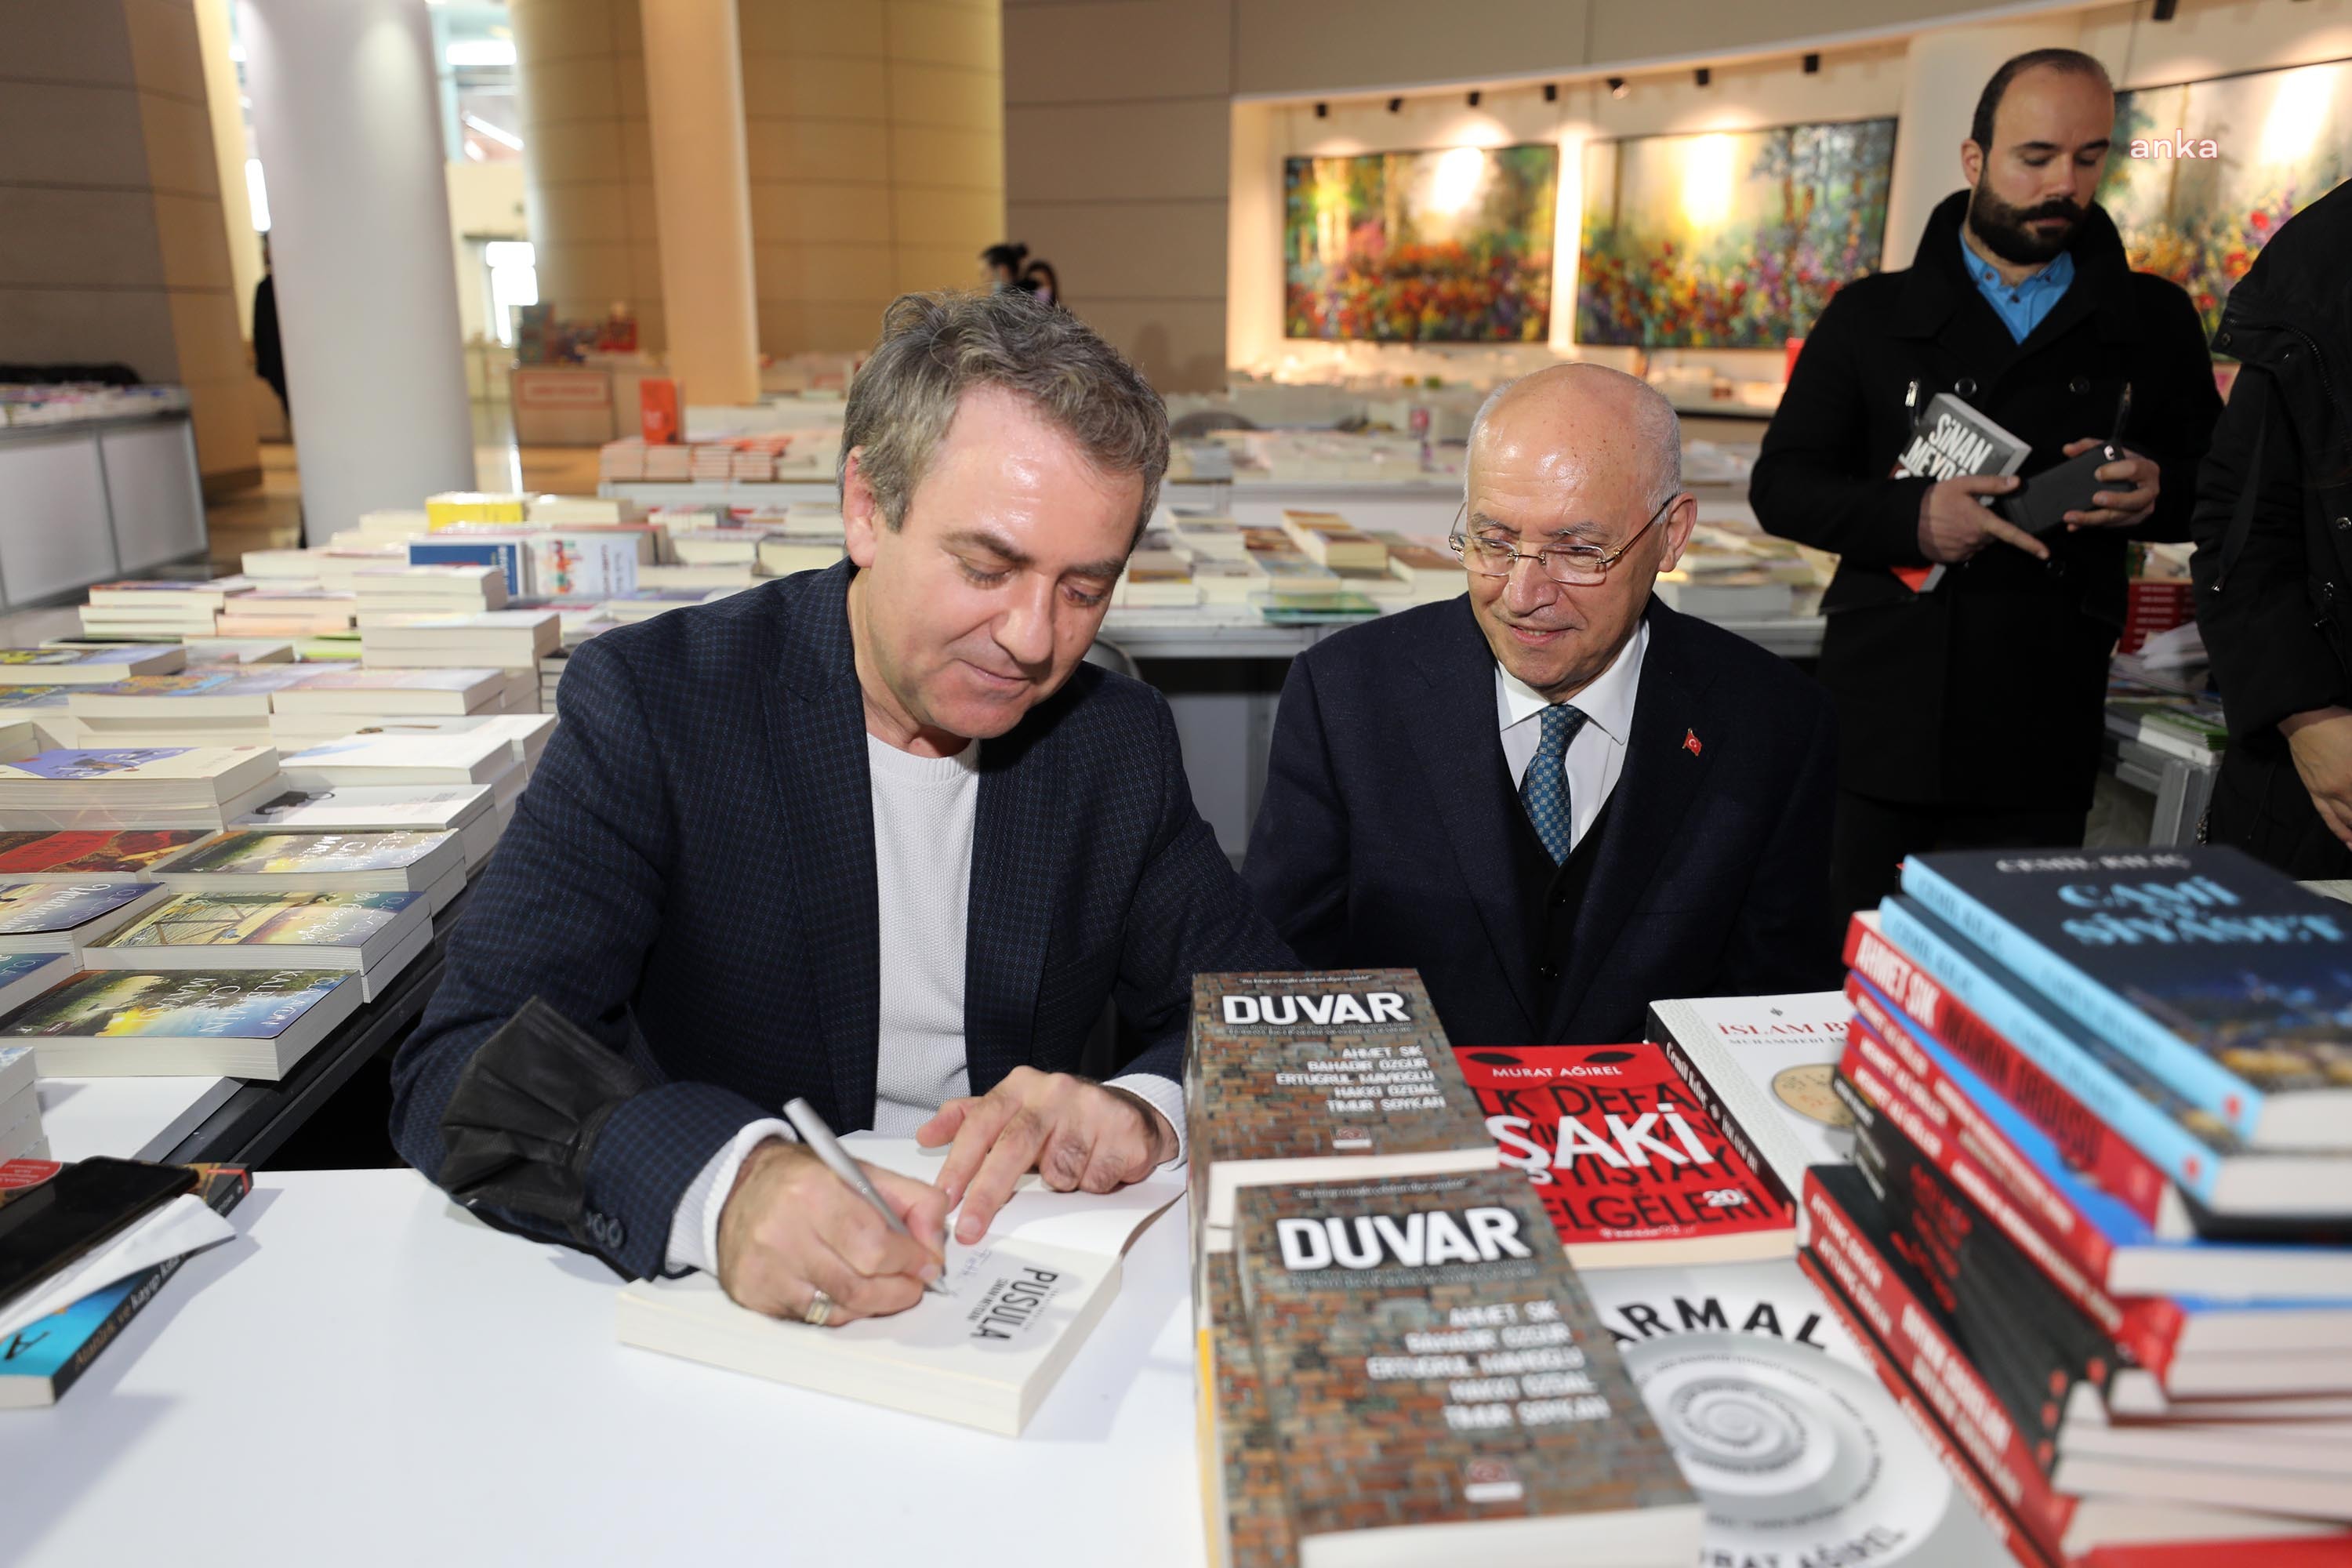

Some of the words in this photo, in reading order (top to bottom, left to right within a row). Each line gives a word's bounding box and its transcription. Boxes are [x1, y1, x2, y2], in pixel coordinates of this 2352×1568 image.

[1222, 992, 1411, 1025] DUVAR
[1342, 1047, 1392, 1058] AHMET
[1492, 1067, 1552, 1078] MURAT
[1560, 1065, 1622, 1077] AĞIREL
[1471, 1088, 1534, 1117] LK
[1548, 1082, 1698, 1116] DEFA
[1486, 1103, 1715, 1185] ŞAKİ
[1541, 1181, 1773, 1229] ELGELERİ
[1276, 1207, 1531, 1270] DUVAR
[970, 1267, 1058, 1340] PUSULA
